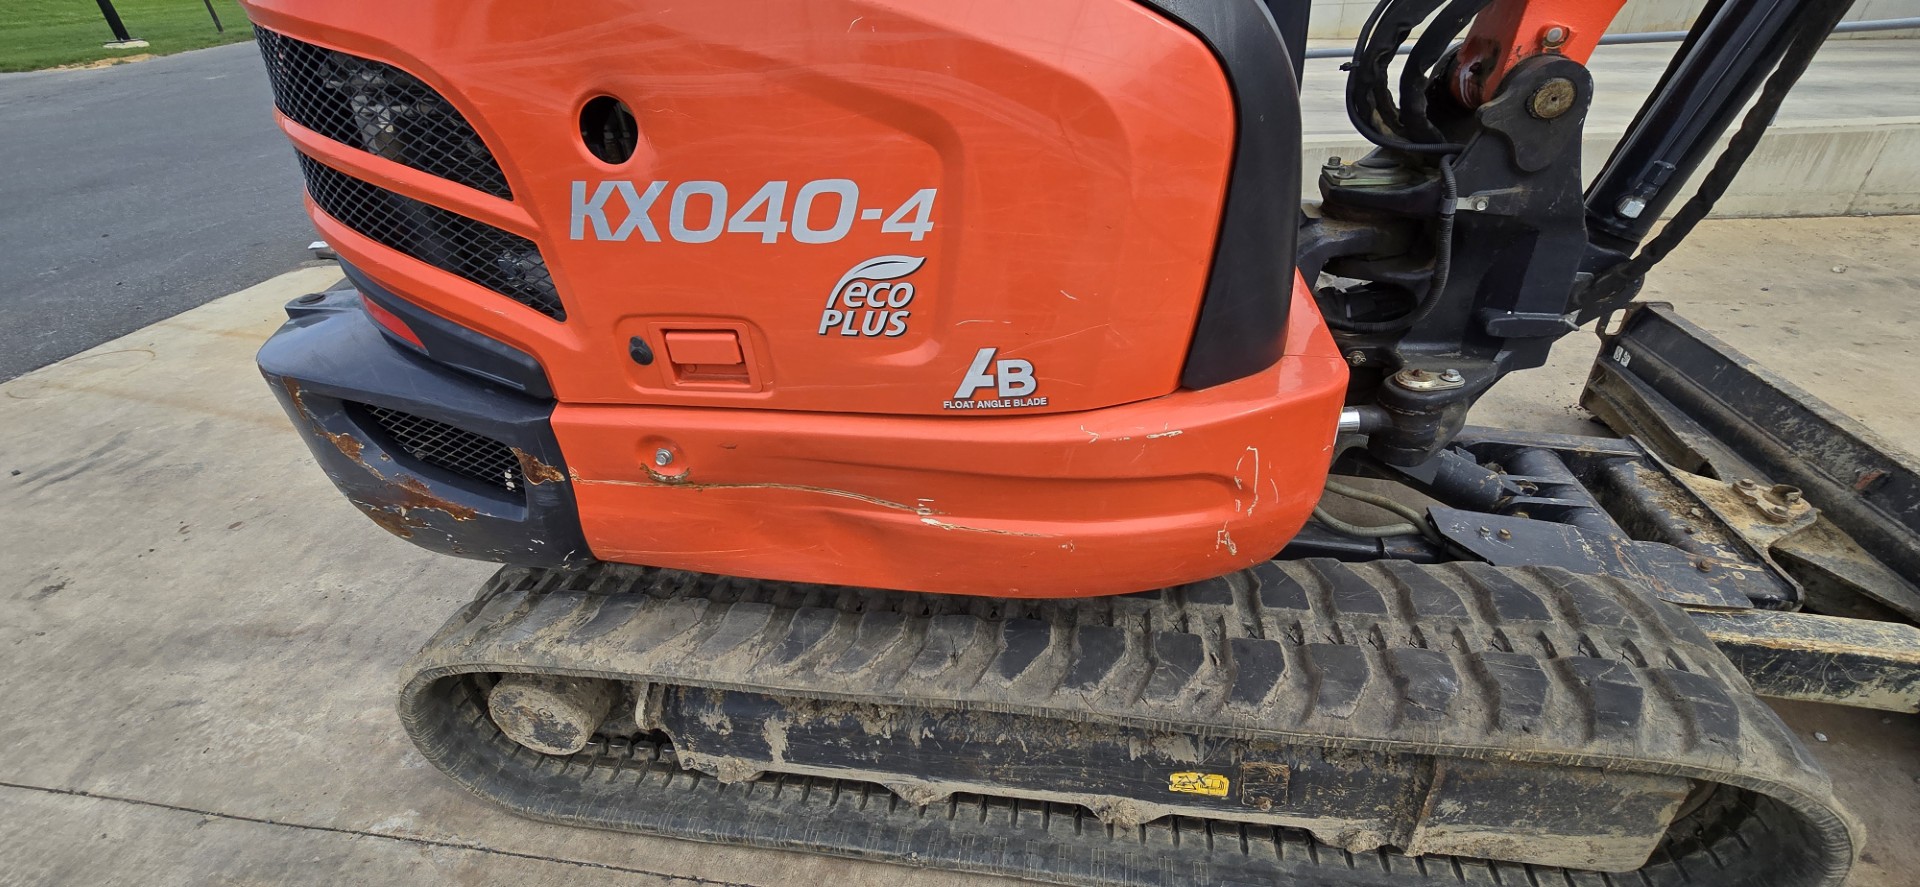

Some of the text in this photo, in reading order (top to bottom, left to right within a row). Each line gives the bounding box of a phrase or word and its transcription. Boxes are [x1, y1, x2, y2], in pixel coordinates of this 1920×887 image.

[569, 178, 938, 244] KX040-4
[842, 281, 915, 309] eco
[818, 310, 911, 337] PLUS
[953, 347, 1038, 399] AB
[943, 397, 1048, 410] FLOAT ANGLE BLADE
